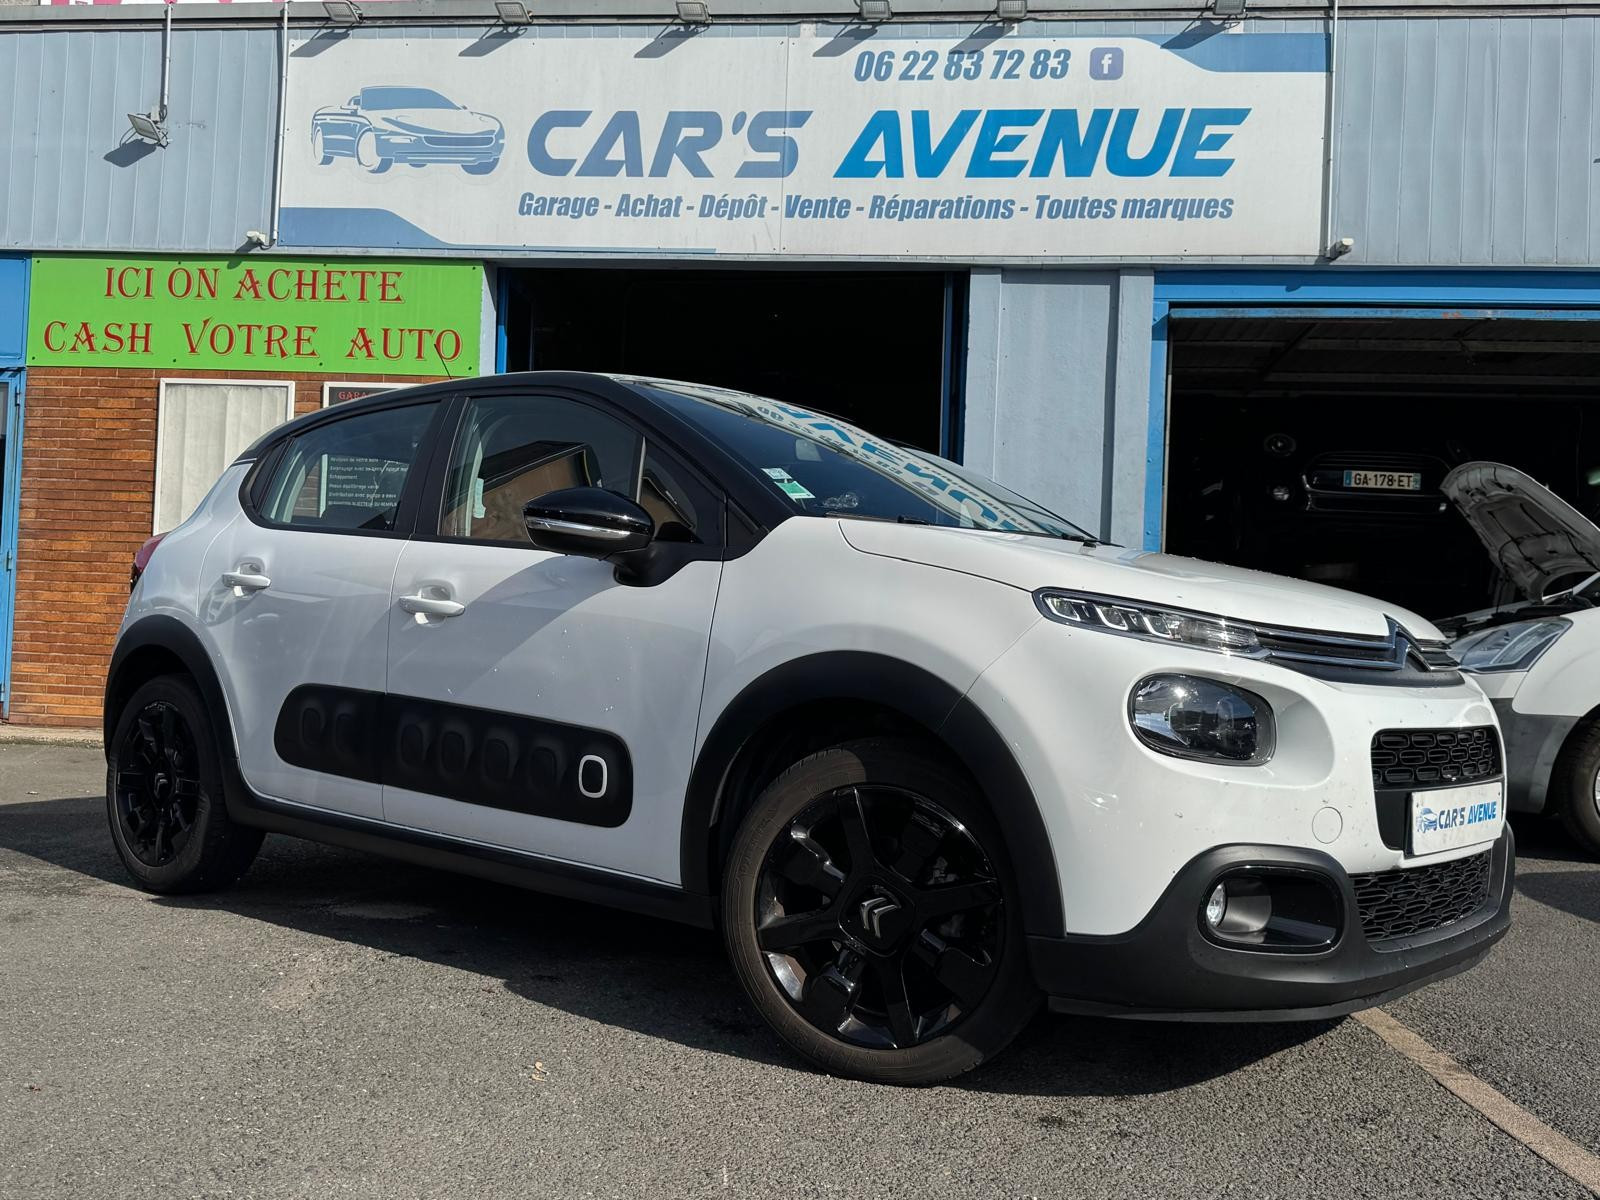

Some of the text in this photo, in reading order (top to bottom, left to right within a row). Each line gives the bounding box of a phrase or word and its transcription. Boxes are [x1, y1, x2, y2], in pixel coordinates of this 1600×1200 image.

[854, 48, 1071, 81] 06 22 83 72 83
[527, 107, 1252, 178] CAR'S AVENUE
[518, 192, 599, 219] Garage
[615, 193, 684, 217] Achat
[699, 194, 768, 220] Dépôt
[784, 195, 851, 218] Vente
[868, 195, 1016, 221] Réparations
[1035, 196, 1116, 219] Toutes
[1121, 198, 1234, 221] marques
[104, 267, 405, 303] ICI ON ACHETE
[44, 317, 463, 362] CASH VOTRE AUTO
[1354, 473, 1413, 488] GA-178-ET
[1439, 802, 1497, 829] CAR'S AVENUE
